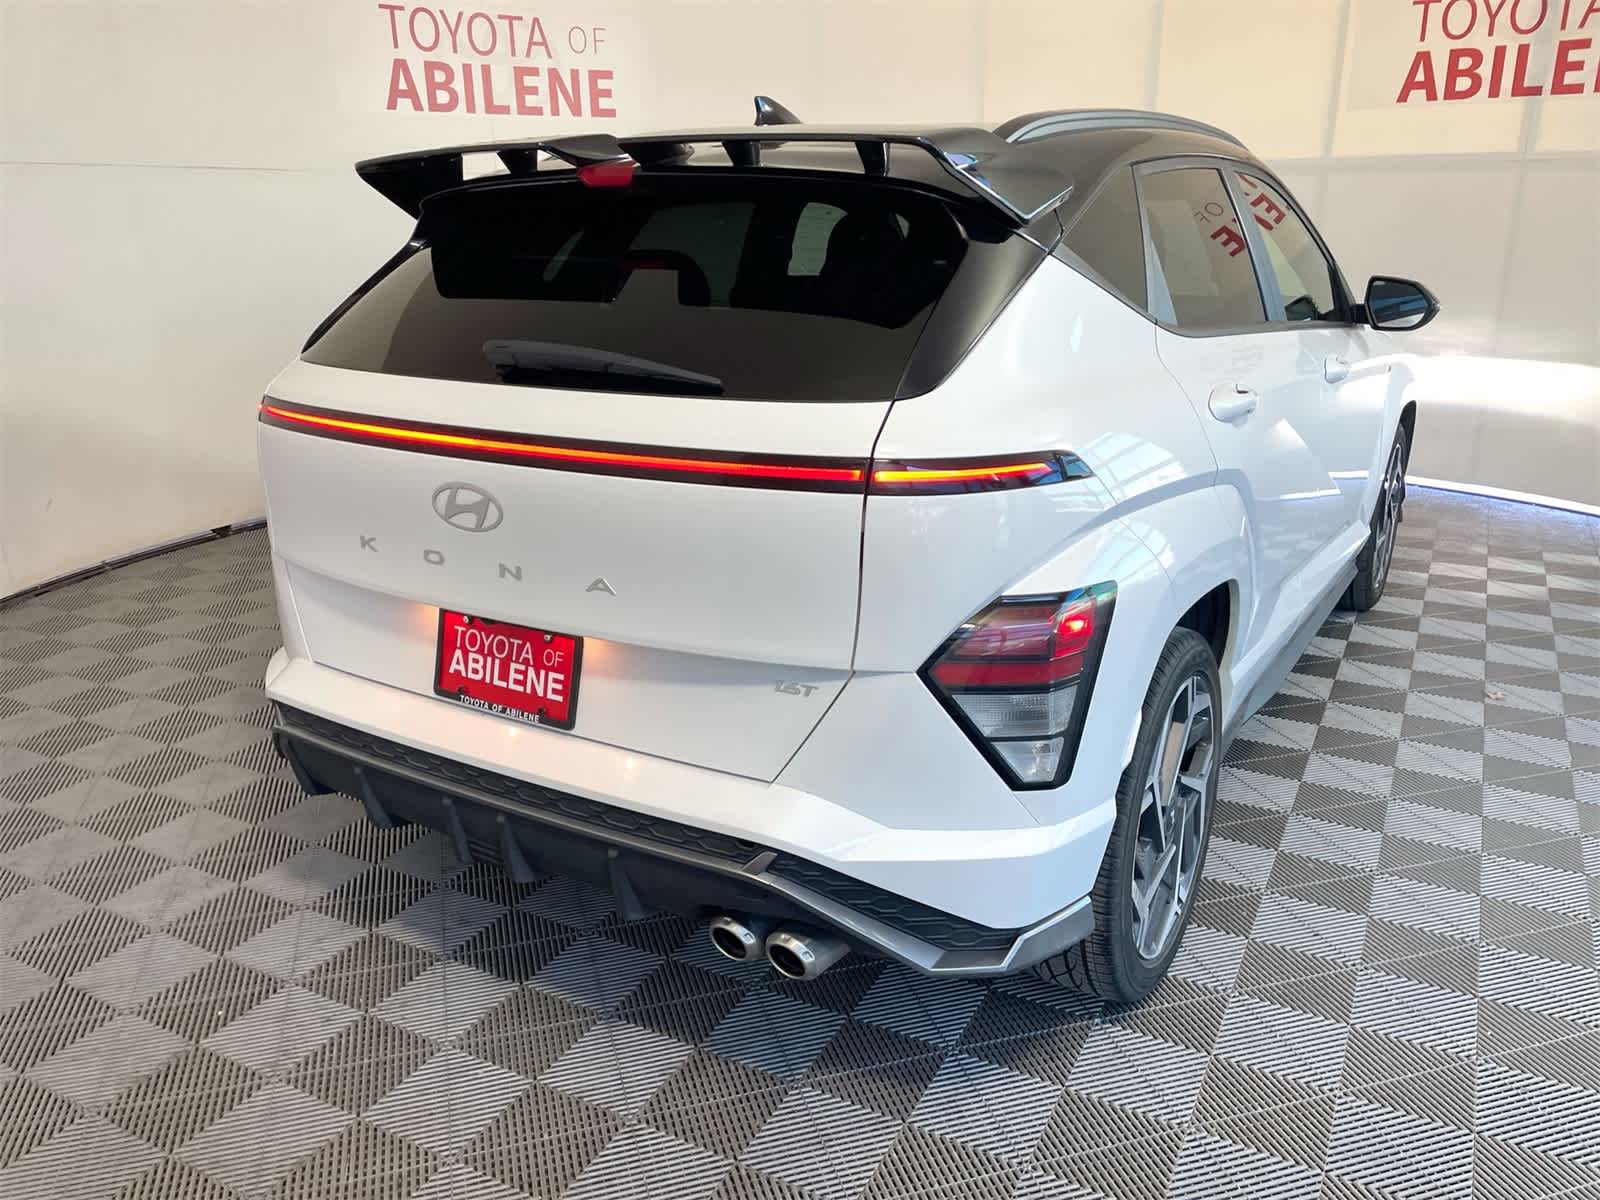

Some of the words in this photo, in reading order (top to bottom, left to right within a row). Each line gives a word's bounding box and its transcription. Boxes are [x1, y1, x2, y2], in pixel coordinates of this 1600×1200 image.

[378, 3, 553, 59] TOYOTA
[568, 26, 606, 54] OF
[386, 58, 617, 118] ABILENE
[1396, 38, 1600, 103] ABILE
[360, 535, 617, 597] KONA
[454, 626, 533, 664] TOYOTA
[543, 649, 564, 667] OF
[449, 649, 564, 702] ABILENE
[460, 695, 489, 710] TOYOTA
[492, 703, 502, 713] OF
[506, 707, 540, 723] ABILENE
